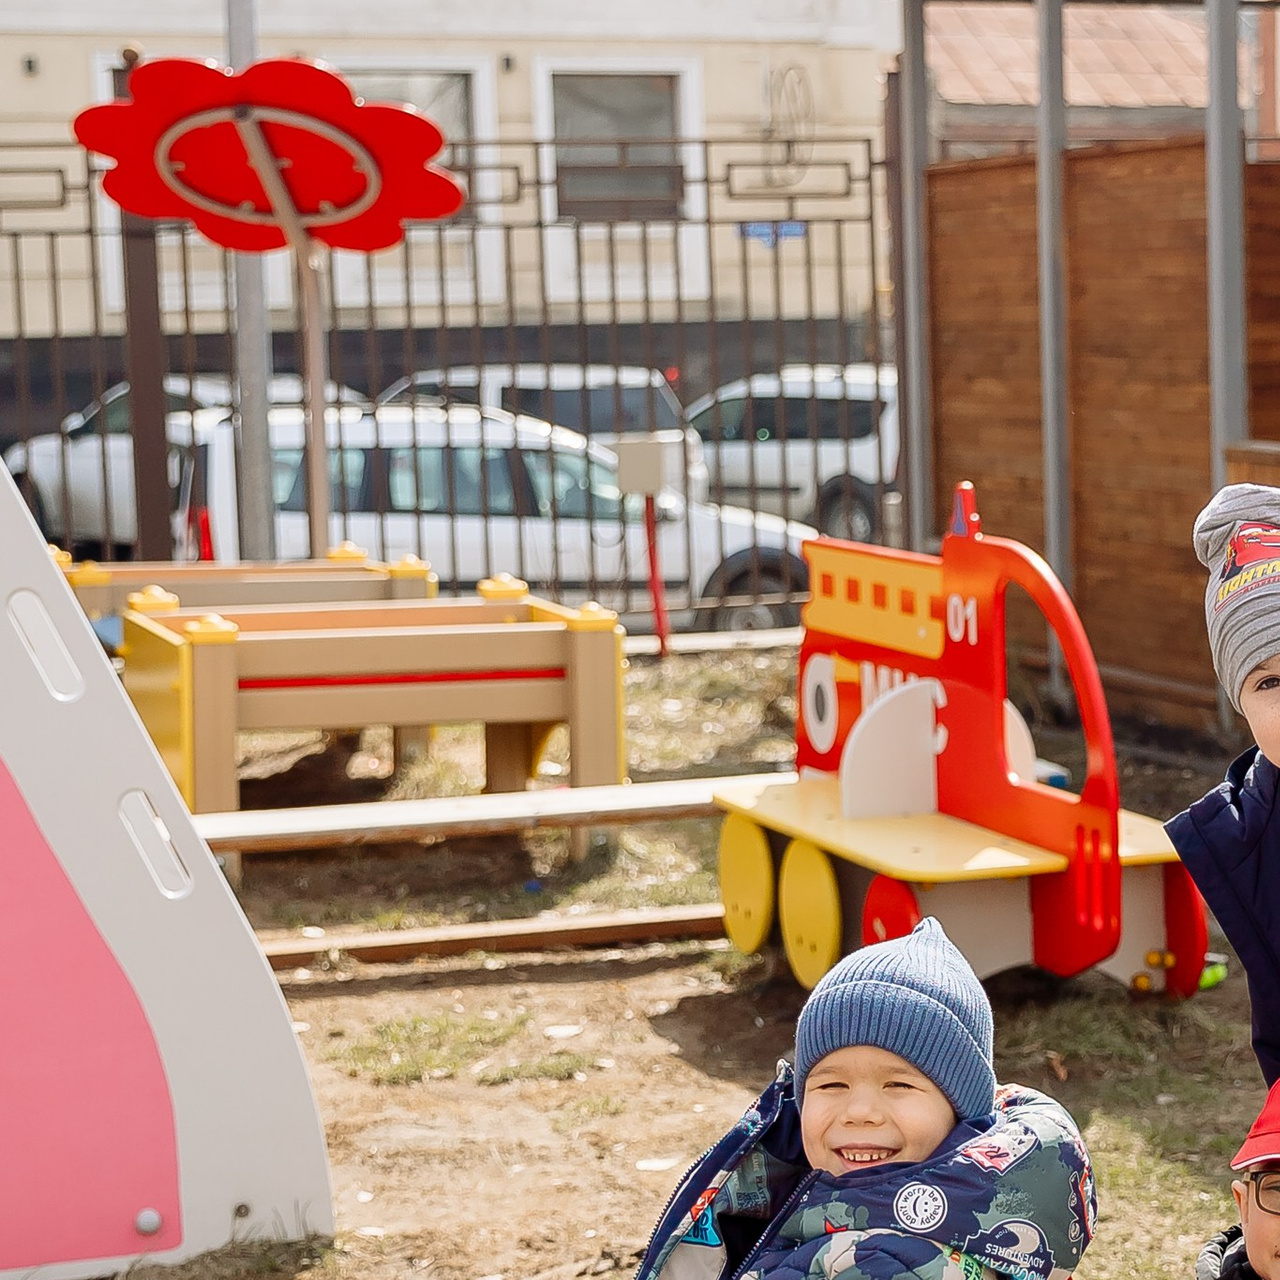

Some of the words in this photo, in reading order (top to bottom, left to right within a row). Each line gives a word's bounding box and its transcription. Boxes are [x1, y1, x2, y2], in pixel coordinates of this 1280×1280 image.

[947, 593, 979, 646] 01
[902, 1187, 928, 1203] worry
[928, 1190, 939, 1203] be
[900, 1205, 917, 1225] don't
[920, 1204, 942, 1226] happy
[985, 1243, 1046, 1269] ADVENTURES
